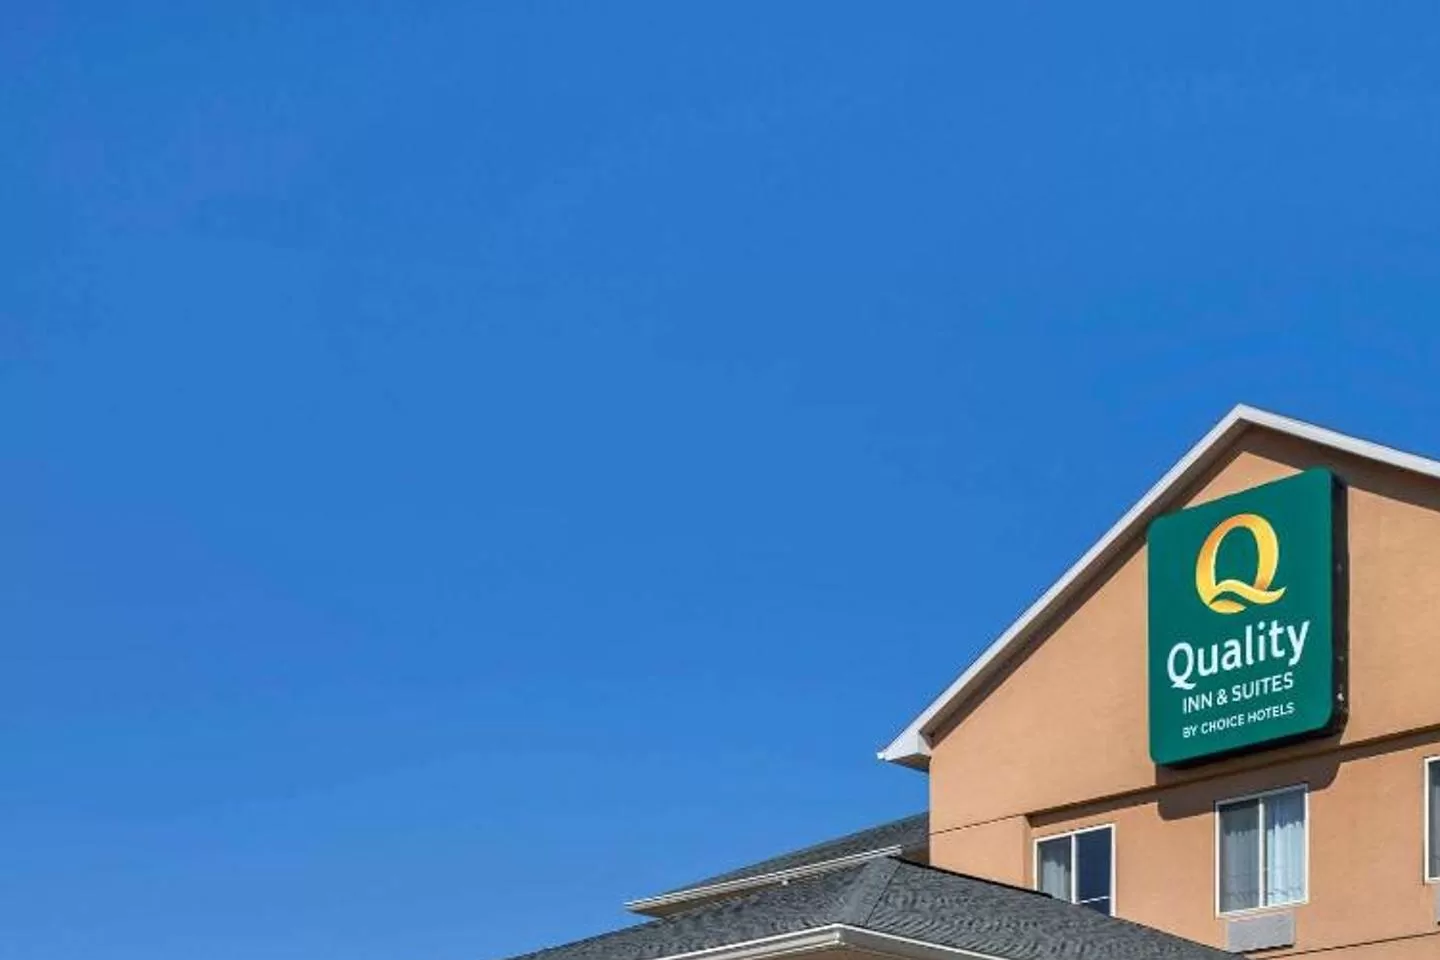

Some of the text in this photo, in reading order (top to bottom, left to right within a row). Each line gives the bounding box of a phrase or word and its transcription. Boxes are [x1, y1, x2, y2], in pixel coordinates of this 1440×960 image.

[1195, 513, 1287, 614] Q
[1167, 620, 1311, 690] Quality
[1182, 671, 1295, 715] INN & SUITES
[1182, 702, 1295, 739] BY CHOICE HOTELS
